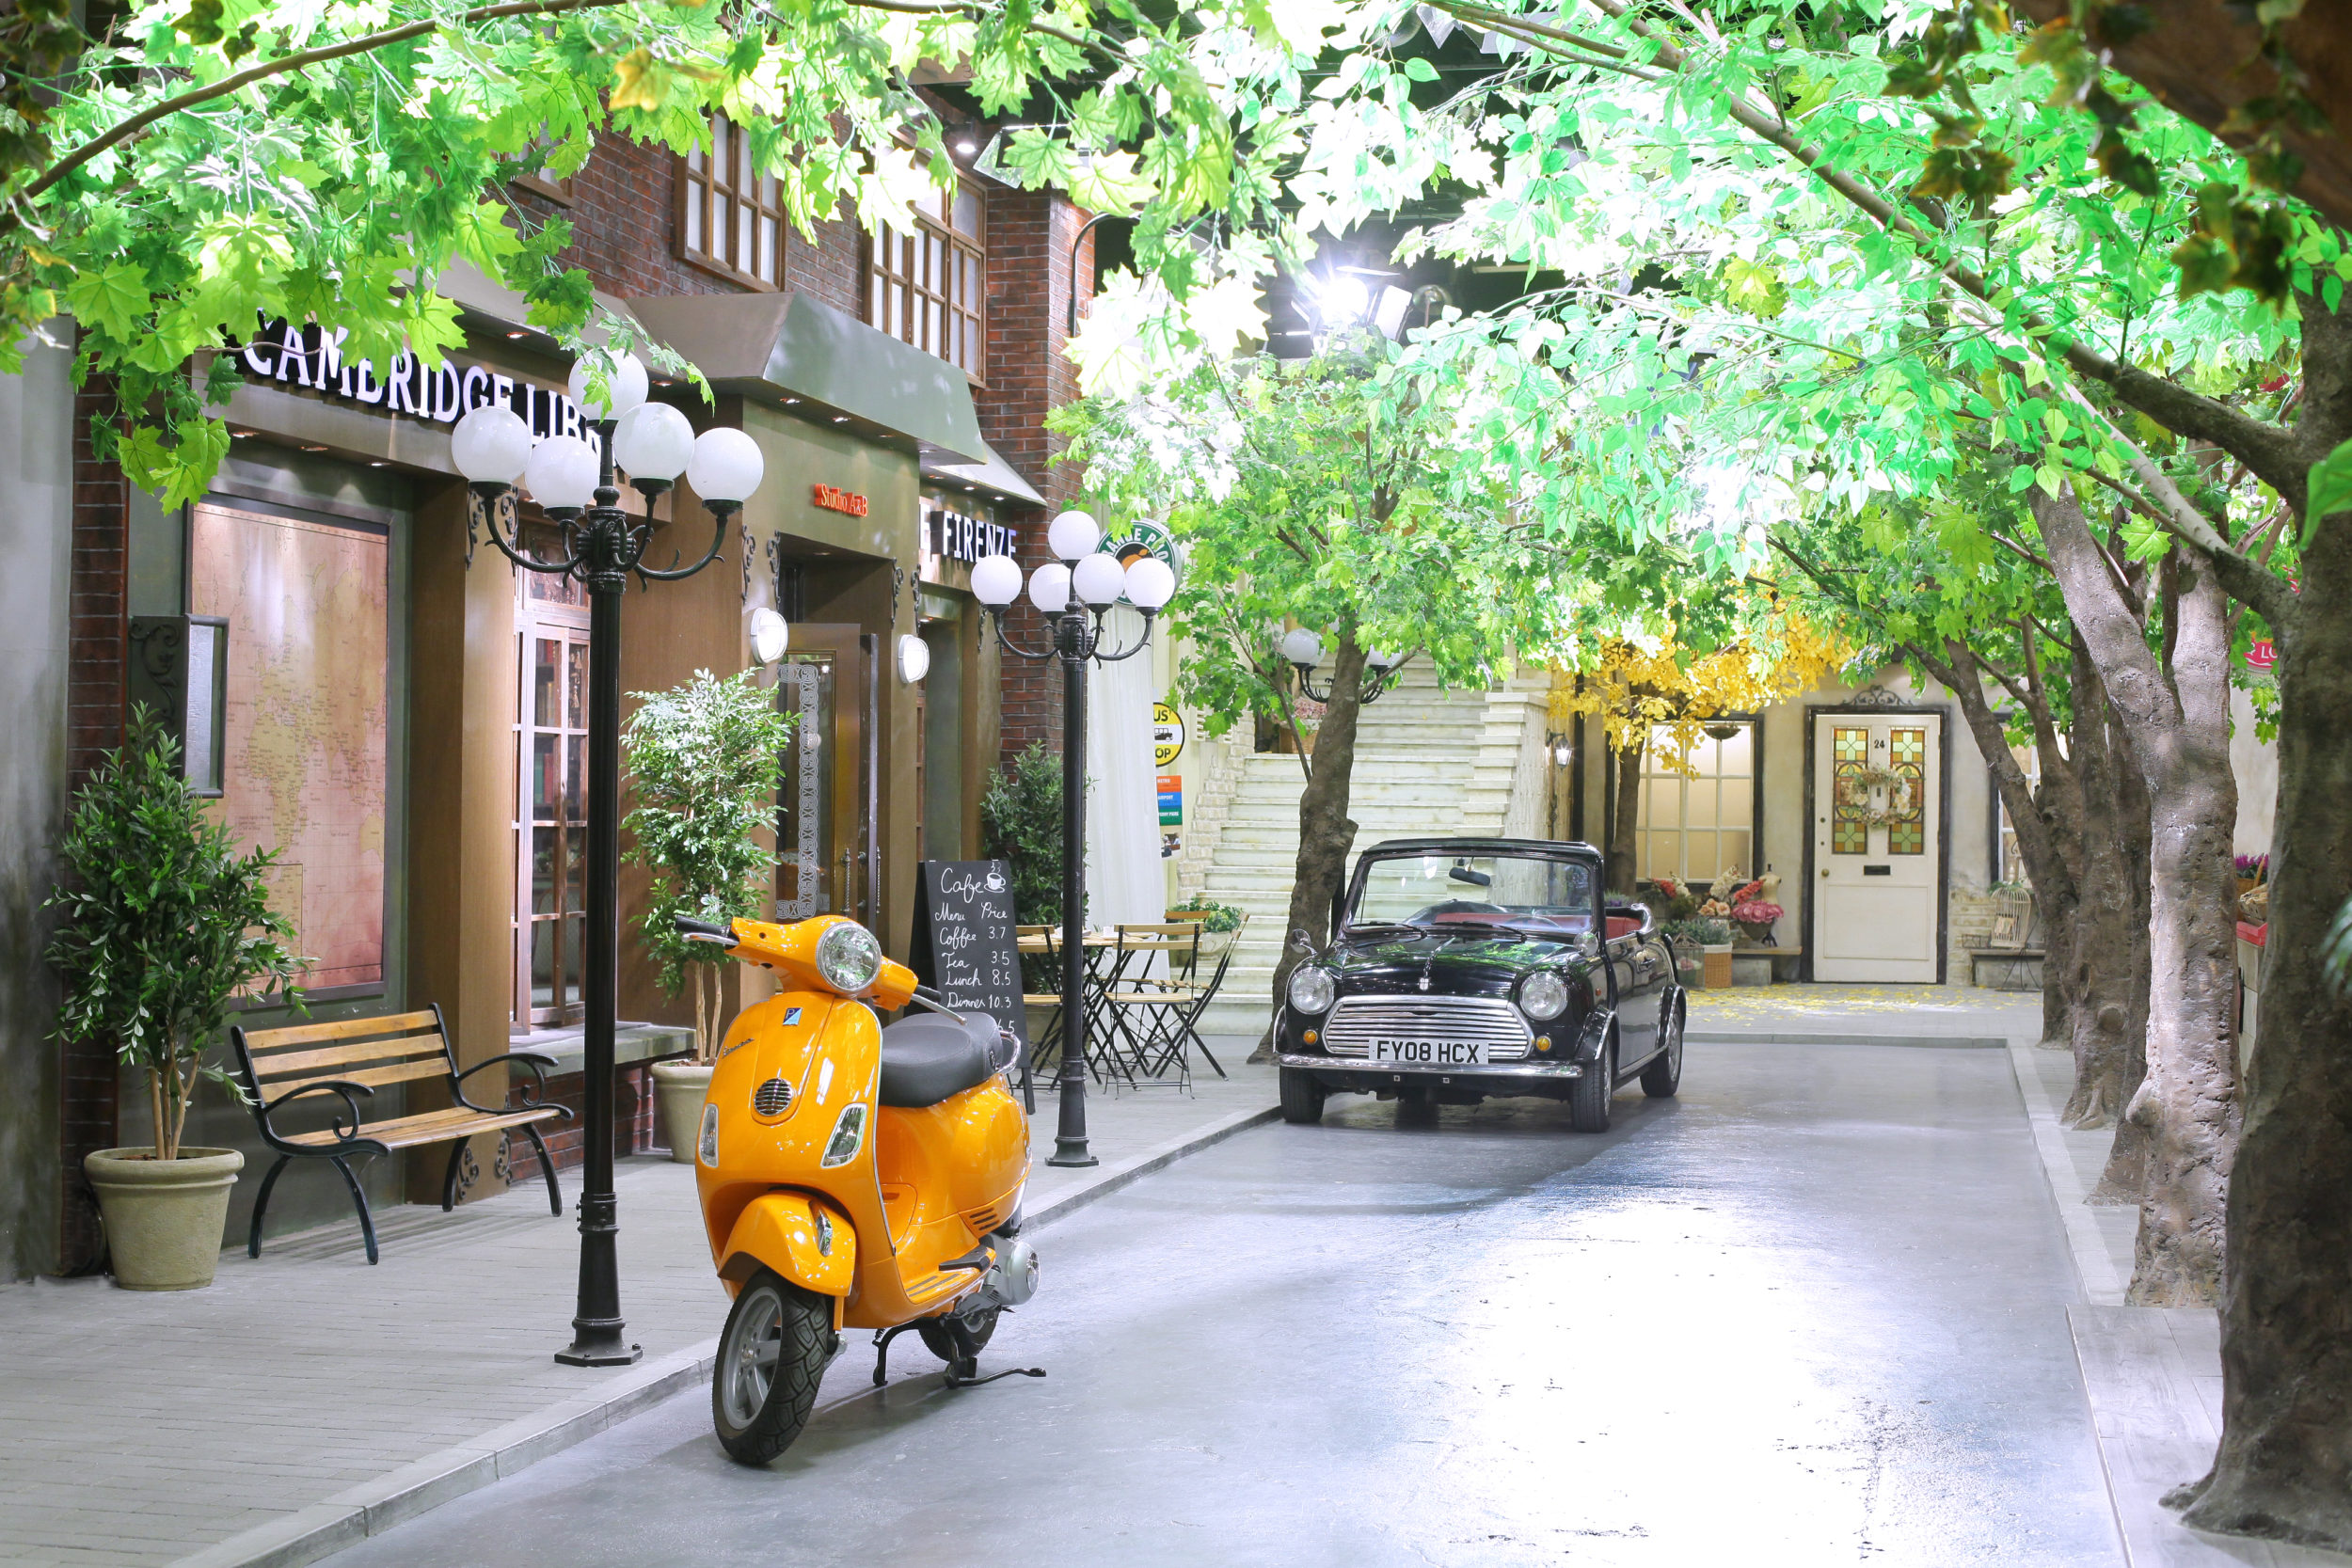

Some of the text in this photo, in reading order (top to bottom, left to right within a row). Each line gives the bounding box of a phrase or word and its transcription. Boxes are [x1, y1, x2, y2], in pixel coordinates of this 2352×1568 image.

[819, 483, 868, 517] Studio A&B
[943, 510, 1017, 562] FIRENZE
[1874, 738, 1885, 749] 24
[941, 867, 984, 903] Cafe
[934, 901, 1008, 921] Menu Price
[939, 926, 1007, 949] Coffee 3.7
[942, 950, 1009, 968] Tea 3.5
[945, 967, 1011, 987] Lunch 8.5
[946, 991, 1011, 1009] Dinner 10.3
[1376, 1040, 1480, 1064] FY08 HCX
